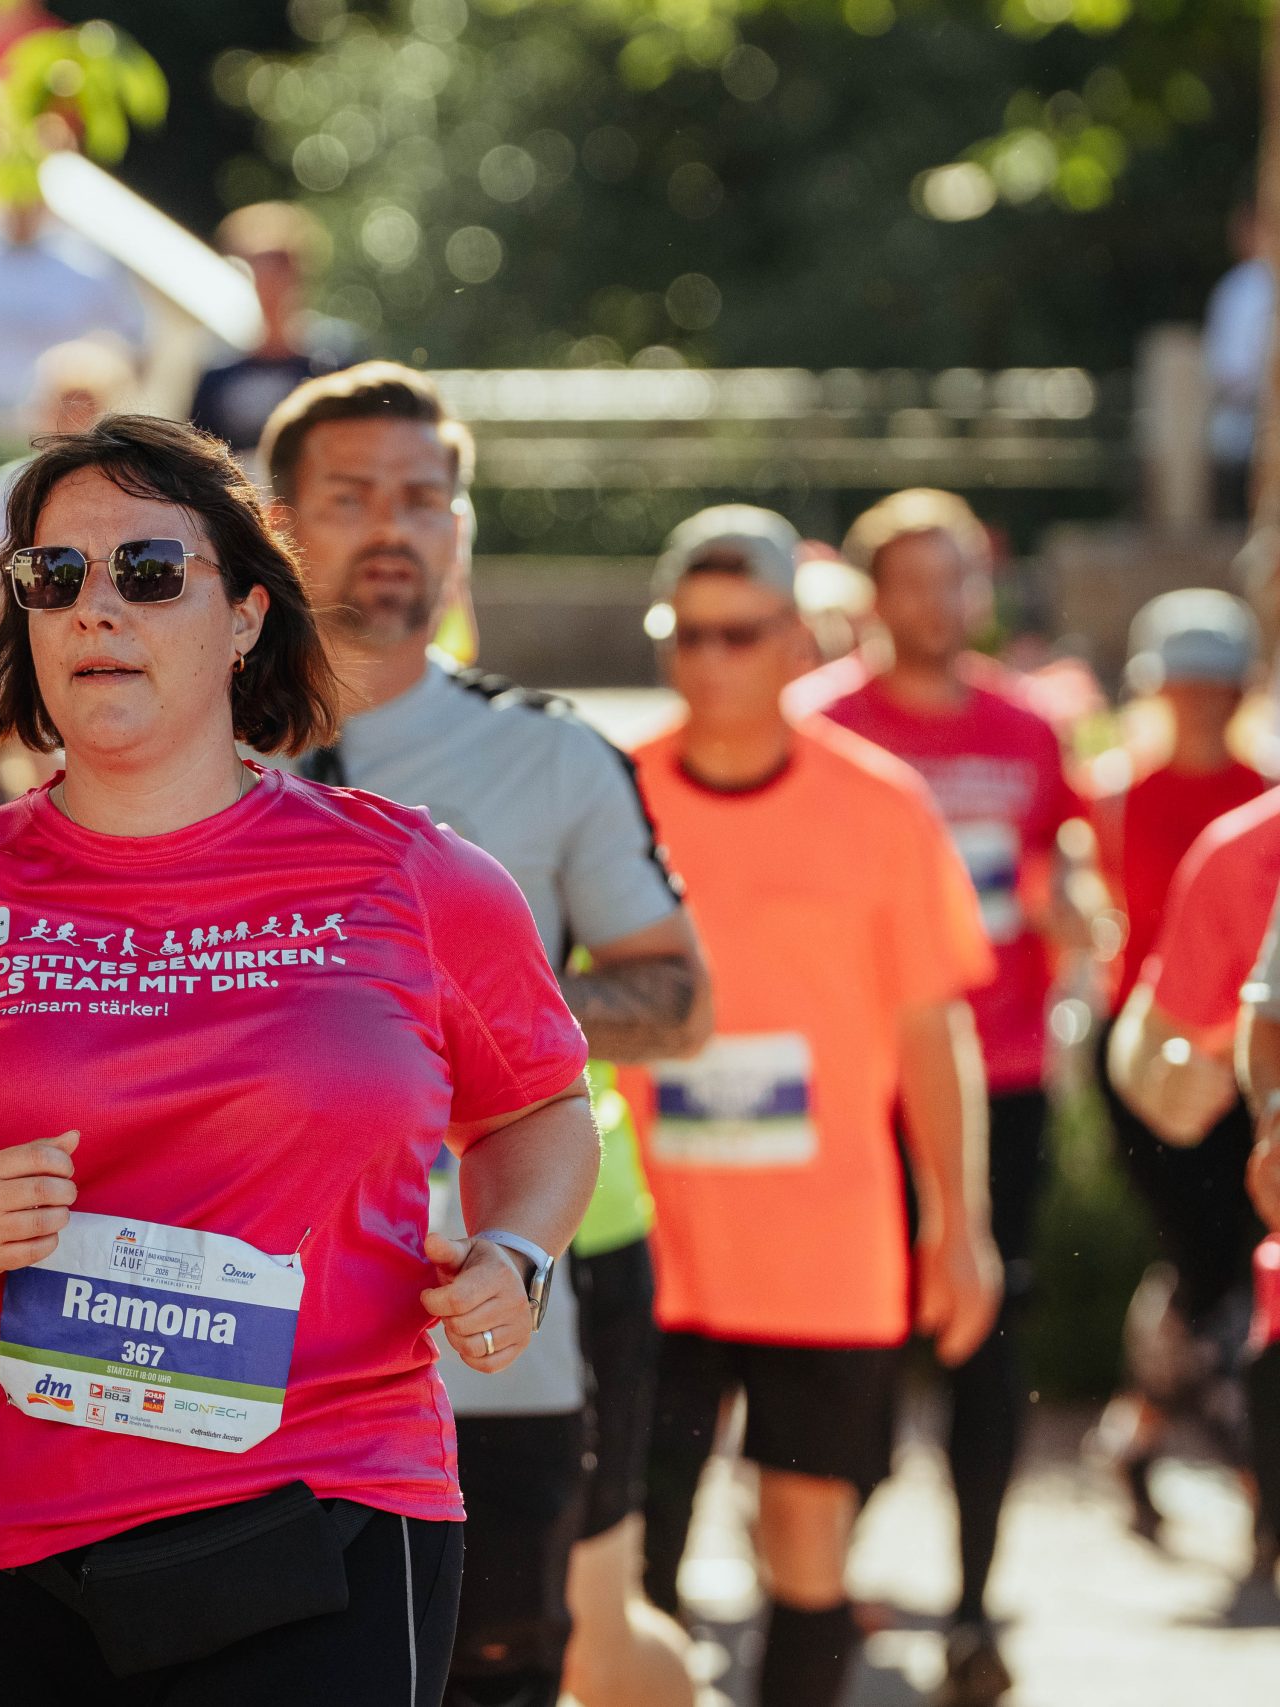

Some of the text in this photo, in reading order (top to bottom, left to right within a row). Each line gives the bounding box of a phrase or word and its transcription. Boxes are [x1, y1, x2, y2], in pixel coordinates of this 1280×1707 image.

[147, 946, 324, 972] BEWIRKEN
[32, 971, 128, 992] TEAM
[139, 975, 201, 994] MIT
[211, 971, 279, 993] DIR.
[88, 999, 169, 1017] stärker!
[120, 1227, 136, 1238] dm
[115, 1245, 145, 1258] FIRMEN
[113, 1255, 143, 1271] LAUF
[61, 1277, 237, 1346] Ramona
[121, 1340, 165, 1367] 367
[106, 1365, 172, 1384] STARTZEIT 18:00 UHR
[35, 1373, 72, 1399] dm
[144, 1390, 165, 1400] SCHUH
[104, 1391, 130, 1403] 88.3
